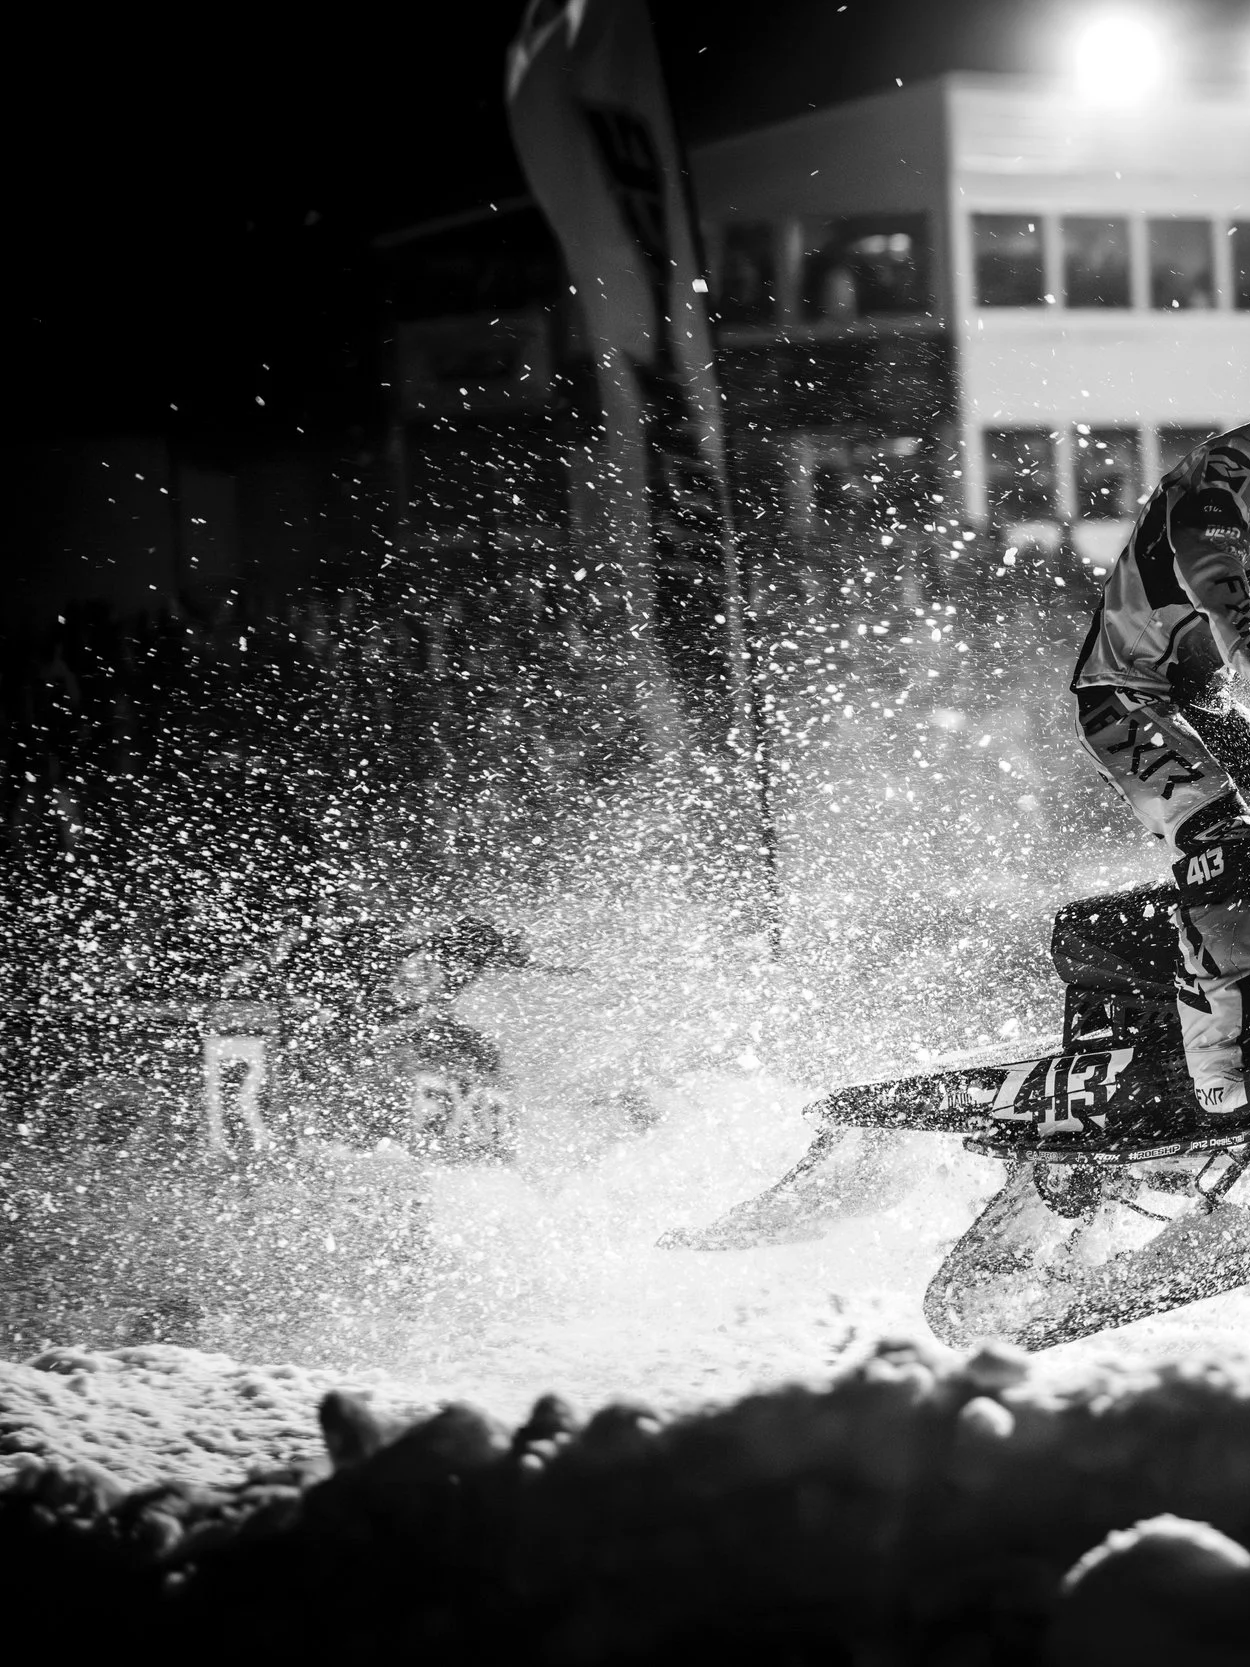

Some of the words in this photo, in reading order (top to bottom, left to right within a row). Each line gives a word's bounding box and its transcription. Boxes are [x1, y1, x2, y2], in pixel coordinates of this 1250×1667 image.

[1083, 704, 1205, 801] FXR
[1186, 846, 1225, 887] 413
[1014, 1052, 1113, 1124] 413
[1195, 1086, 1225, 1106] FXR
